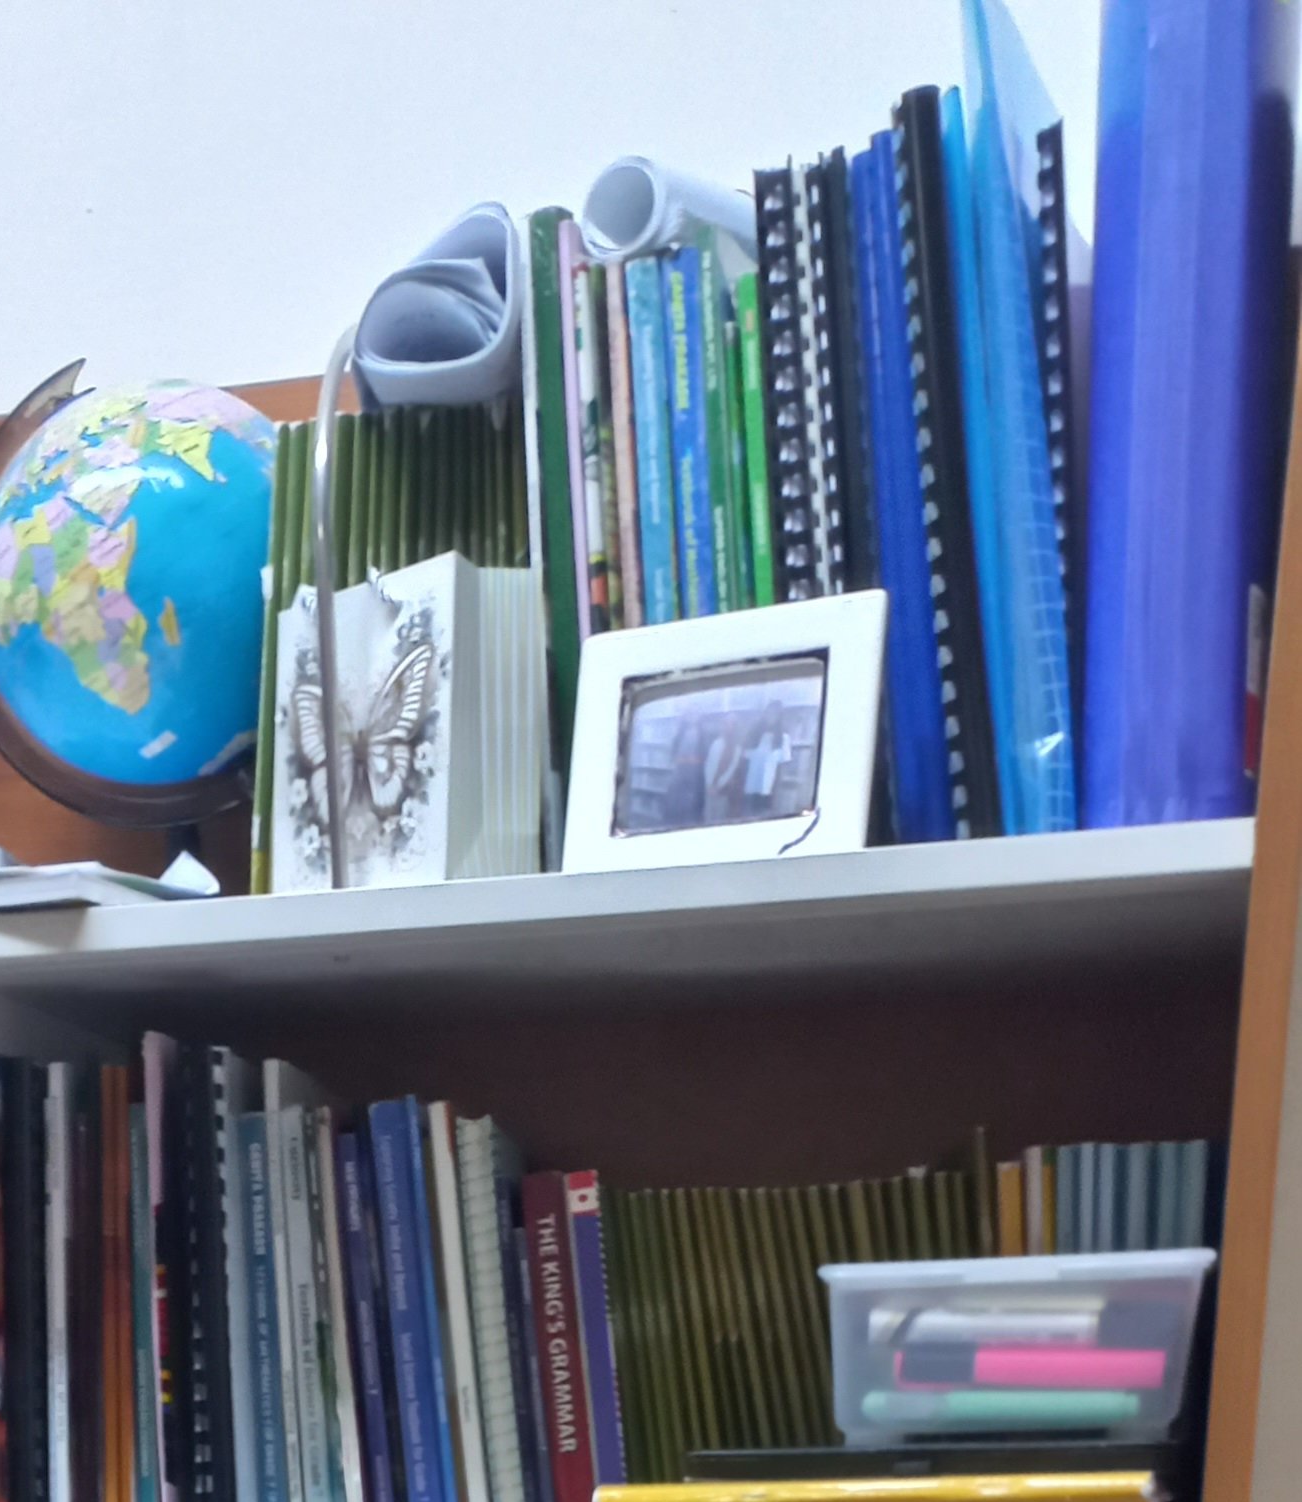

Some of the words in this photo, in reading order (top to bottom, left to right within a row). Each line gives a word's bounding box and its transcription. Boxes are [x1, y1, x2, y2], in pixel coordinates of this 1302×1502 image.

[536, 1213, 559, 1256] THE
[541, 1261, 567, 1334] KING'S
[549, 1337, 579, 1453] GRAMMAR
